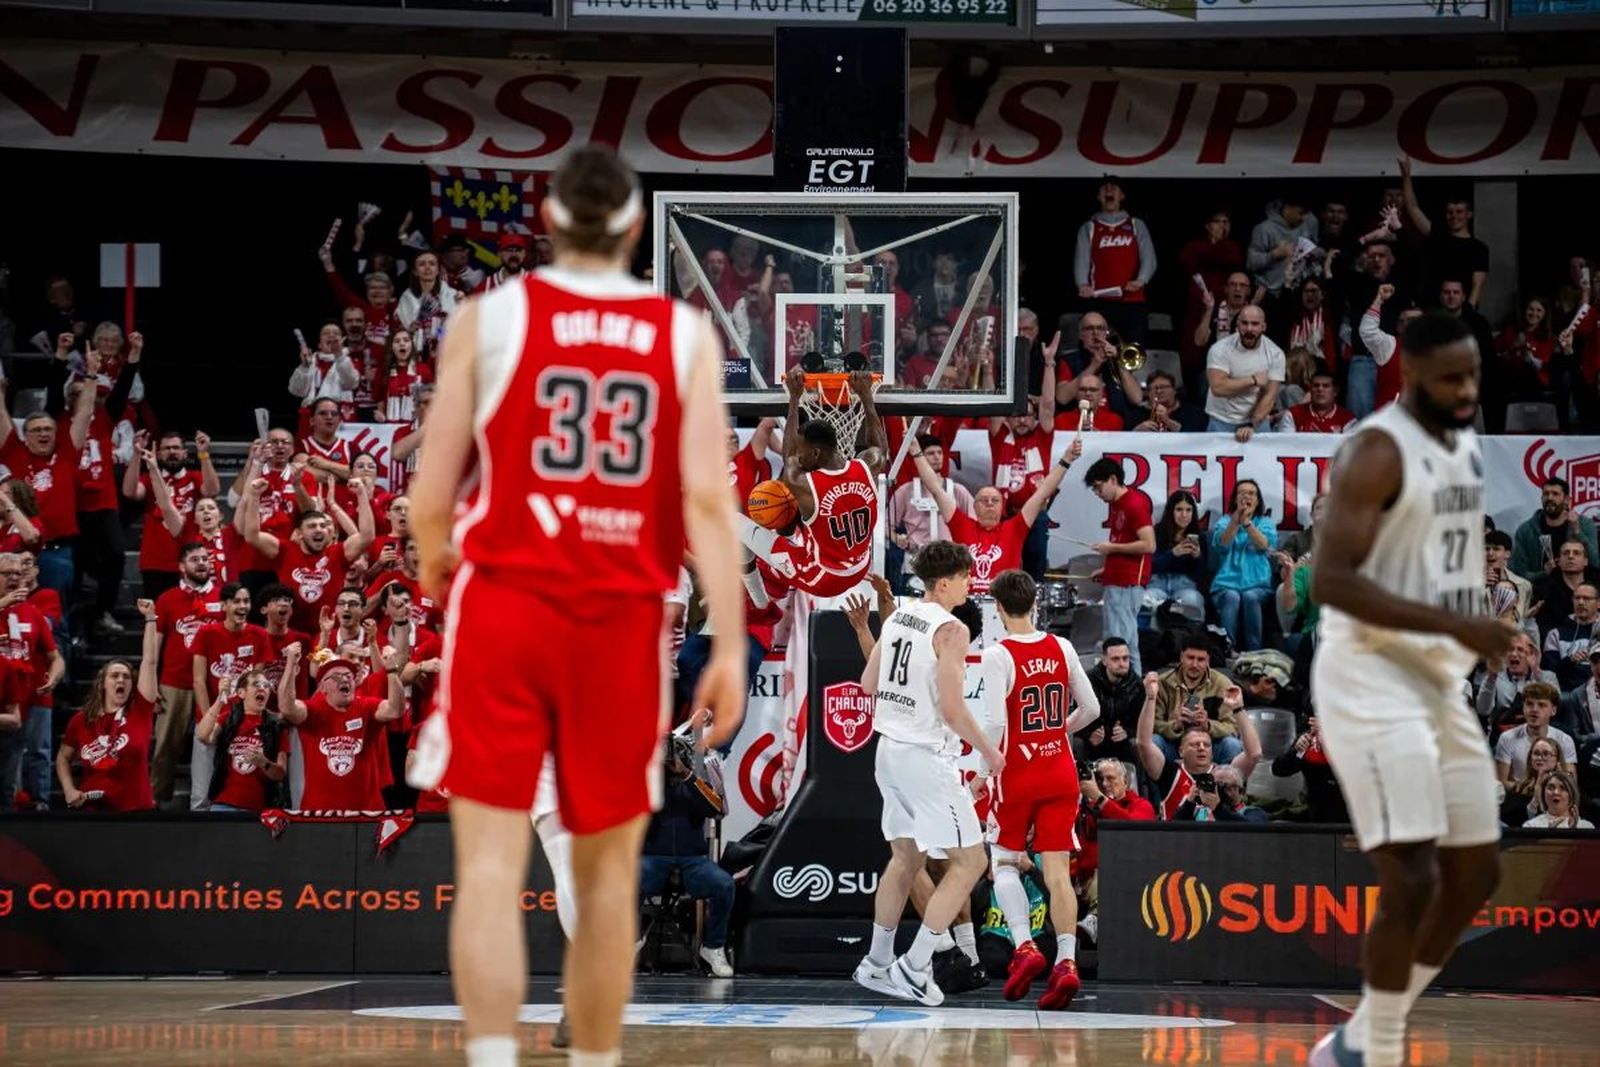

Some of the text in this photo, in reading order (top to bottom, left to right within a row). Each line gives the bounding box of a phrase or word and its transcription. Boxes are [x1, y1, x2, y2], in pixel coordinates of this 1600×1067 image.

[808, 159, 875, 184] EGT
[531, 364, 660, 487] 33
[819, 481, 875, 516] CUTHBERTSON
[828, 505, 872, 551] 40
[1442, 527, 1470, 574] 27
[888, 637, 913, 687] 19
[1020, 658, 1060, 678] LERAY
[828, 696, 872, 716] CHALON
[1019, 681, 1065, 734] 20
[28, 881, 283, 911] Communities
[296, 883, 422, 911] Across
[435, 885, 556, 911] Fce
